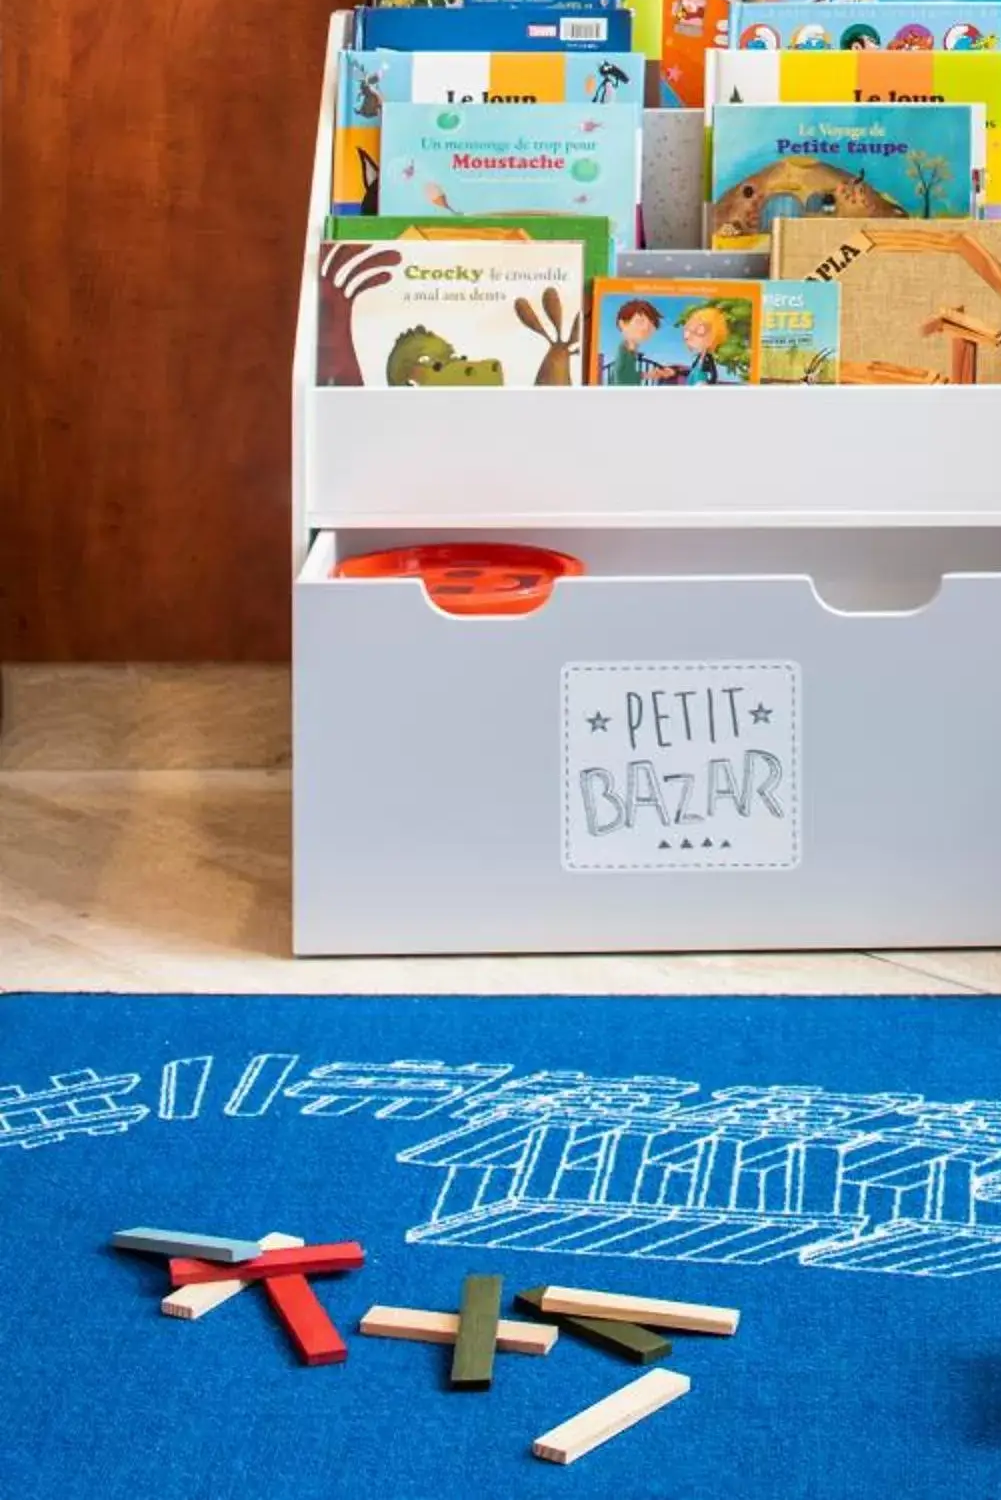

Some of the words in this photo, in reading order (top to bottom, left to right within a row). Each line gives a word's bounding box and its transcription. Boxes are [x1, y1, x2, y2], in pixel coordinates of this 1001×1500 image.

[818, 122, 866, 140] Voyage
[868, 121, 886, 136] de
[421, 138, 441, 150] Un
[533, 141, 561, 154] trop
[565, 142, 596, 155] pour
[776, 139, 840, 154] Petite
[847, 140, 909, 157] taupe
[451, 153, 566, 171] Moustache
[805, 243, 861, 282] PLA
[403, 265, 484, 283] Crocky
[413, 287, 439, 301] mal
[626, 687, 744, 750] PETIT
[579, 749, 784, 837] BAZAR
